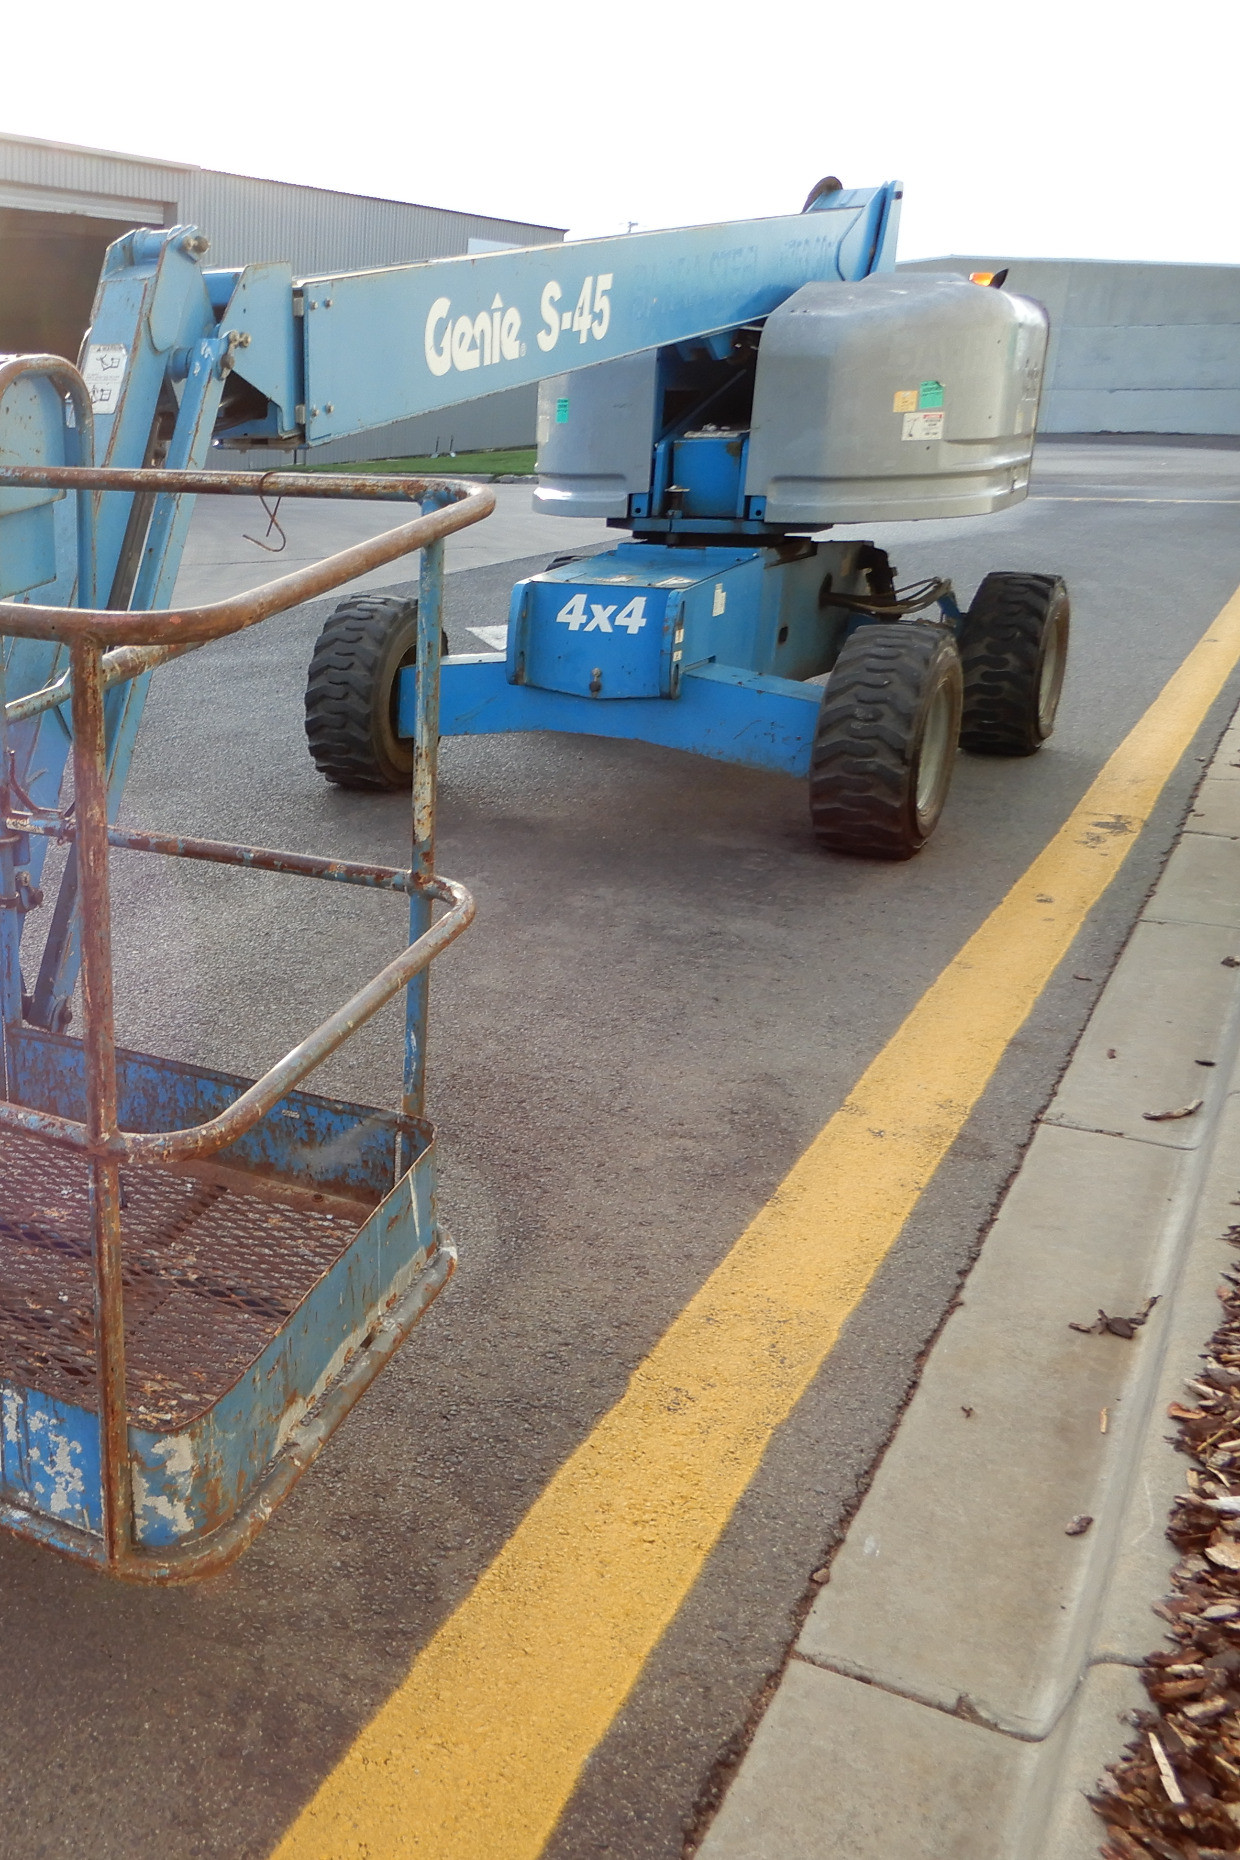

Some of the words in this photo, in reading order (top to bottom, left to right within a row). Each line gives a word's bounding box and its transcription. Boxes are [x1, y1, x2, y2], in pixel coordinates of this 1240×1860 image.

[424, 292, 522, 377] Genie
[536, 273, 614, 352] S-45
[556, 593, 647, 635] 4x4
